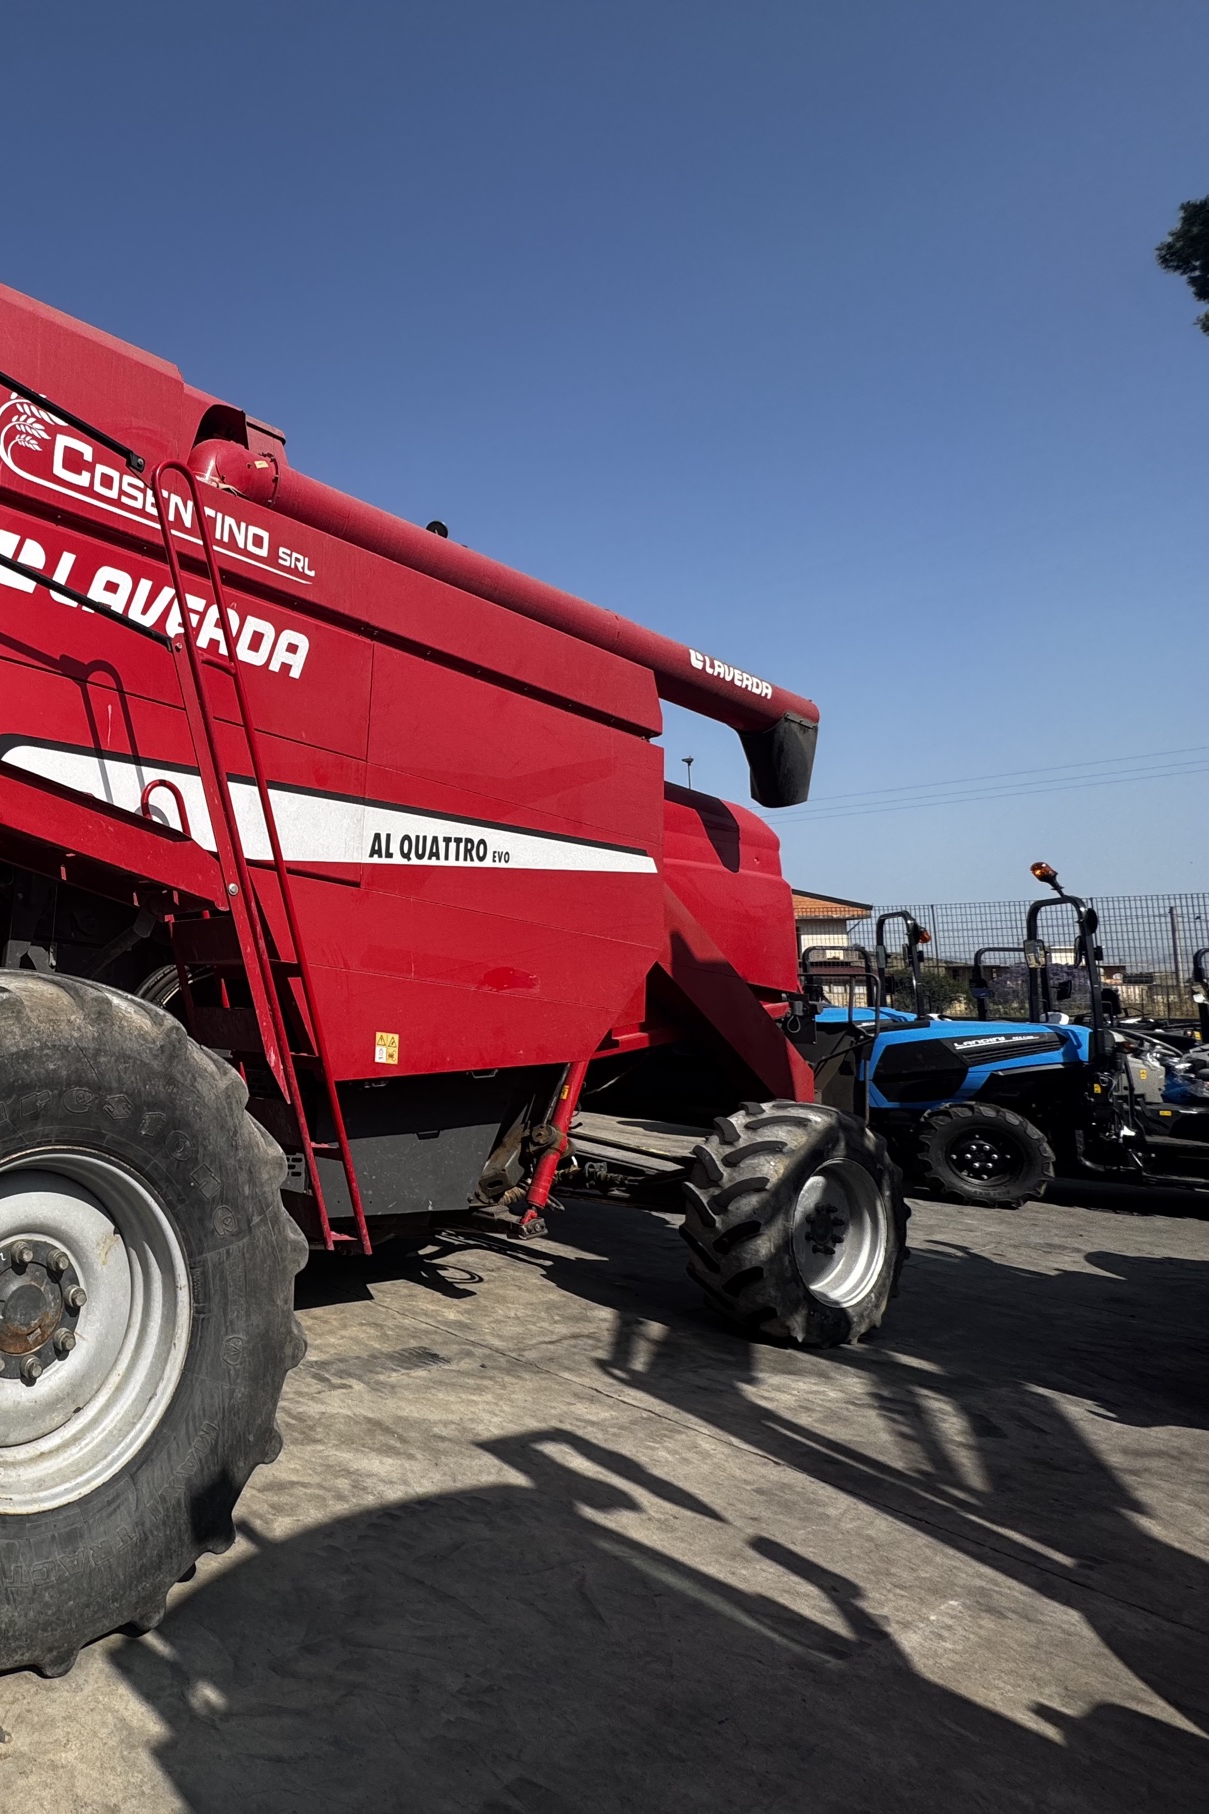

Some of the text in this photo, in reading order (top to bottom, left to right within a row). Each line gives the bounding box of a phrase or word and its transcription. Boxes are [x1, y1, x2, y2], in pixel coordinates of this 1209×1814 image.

[277, 546, 315, 577] SRL
[49, 551, 310, 679] LAVERDA
[704, 655, 773, 699] LAVERDA
[368, 832, 510, 864] AL QUATTRO EVO
